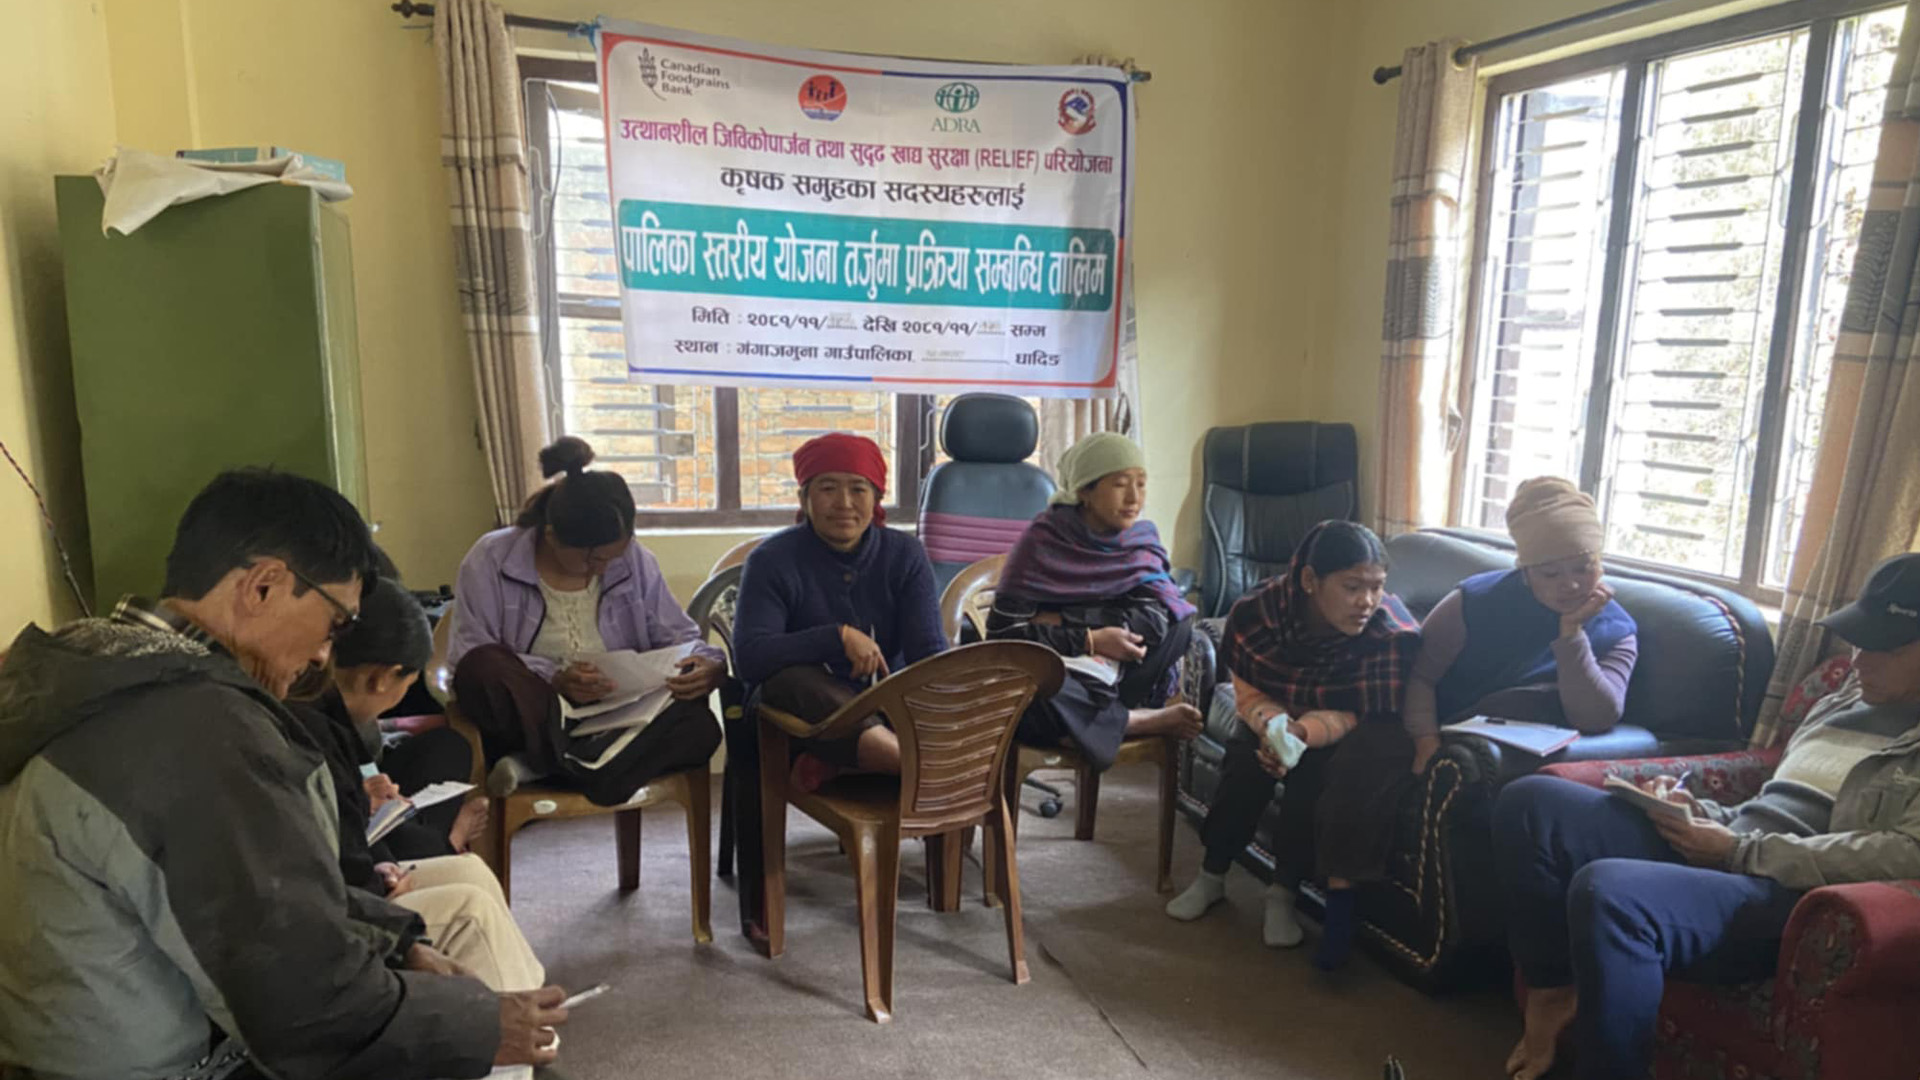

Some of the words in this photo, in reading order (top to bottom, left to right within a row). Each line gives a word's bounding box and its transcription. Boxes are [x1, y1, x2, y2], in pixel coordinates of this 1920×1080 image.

[660, 57, 721, 77] Canadian
[660, 71, 731, 91] Foodgrains
[661, 82, 693, 97] Bank
[931, 117, 981, 134] ADRA
[620, 118, 707, 146] उत्थानशील
[713, 122, 811, 156] जिविकोपार्जन
[815, 139, 845, 159] तथा
[850, 142, 886, 167] सुदृढ
[891, 145, 923, 165] खाद्य
[927, 147, 970, 171] सुरक्षा
[974, 148, 1040, 175] (RELIEF)
[1044, 147, 1114, 175] परियोजना
[720, 166, 785, 195] कृषक
[792, 173, 877, 202] समुहका
[621, 210, 697, 276] पालिका
[702, 218, 768, 281] स्तरीय
[774, 221, 839, 285] योजना
[844, 229, 900, 300] तर्जुमा
[905, 228, 971, 294] प्रक्रिया
[974, 233, 1045, 295] सम्बन्धि
[1049, 236, 1108, 298] तालिम
[691, 306, 730, 325] मिति
[863, 314, 897, 333] देखि
[1010, 323, 1047, 338] सम्म
[674, 338, 719, 355] स्थान
[736, 341, 819, 362] गंगाजमुना
